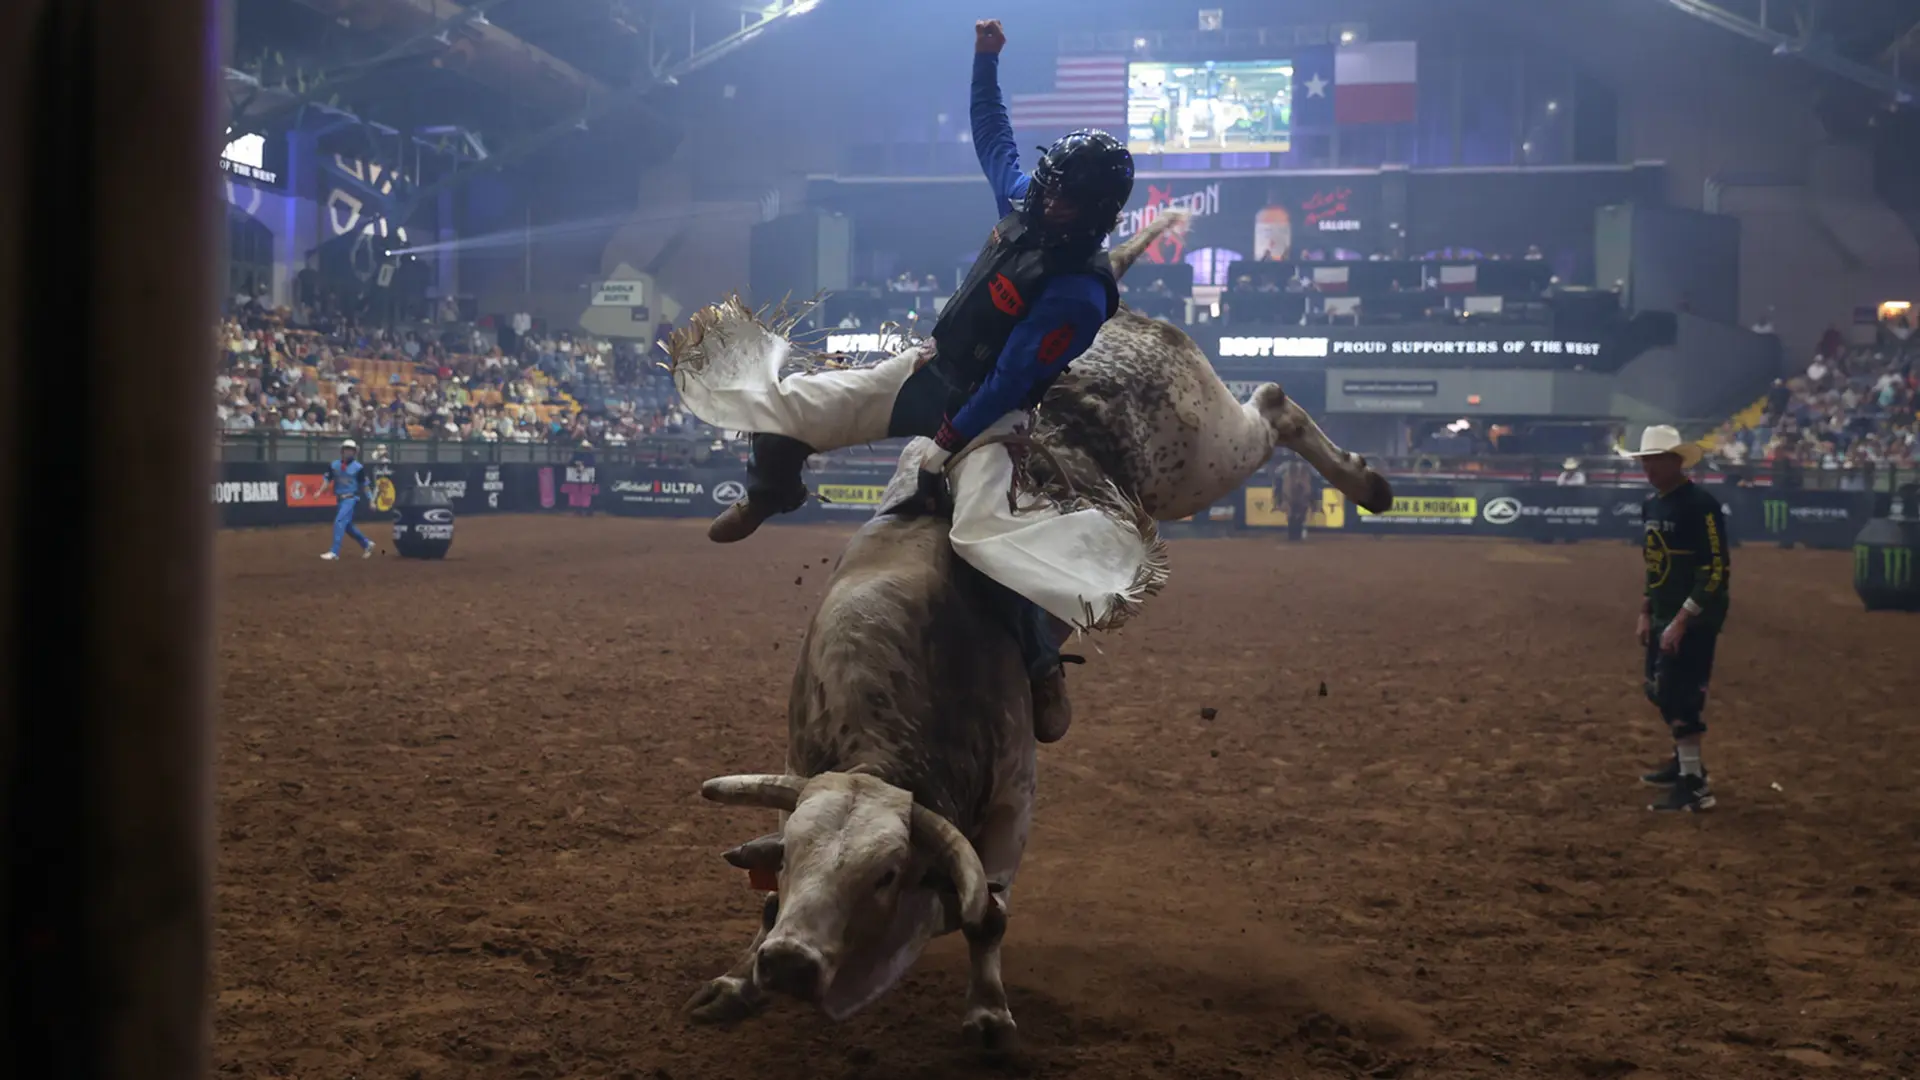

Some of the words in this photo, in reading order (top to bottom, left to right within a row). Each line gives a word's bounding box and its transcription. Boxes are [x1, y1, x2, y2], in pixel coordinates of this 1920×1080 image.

[219, 159, 231, 171] OF
[232, 163, 252, 178] THE
[252, 167, 277, 184] WEST
[1103, 183, 1221, 248] ENDETON
[1318, 219, 1362, 231] SALOON
[1333, 341, 1386, 353] PROUD
[1391, 341, 1497, 353] SUPPORTERS
[1502, 341, 1525, 353] OF
[1530, 341, 1562, 353] THE
[1565, 342, 1600, 355] WEST
[242, 481, 279, 502] BARN
[662, 482, 705, 494] ULTRA
[1423, 500, 1470, 513] MORGAN
